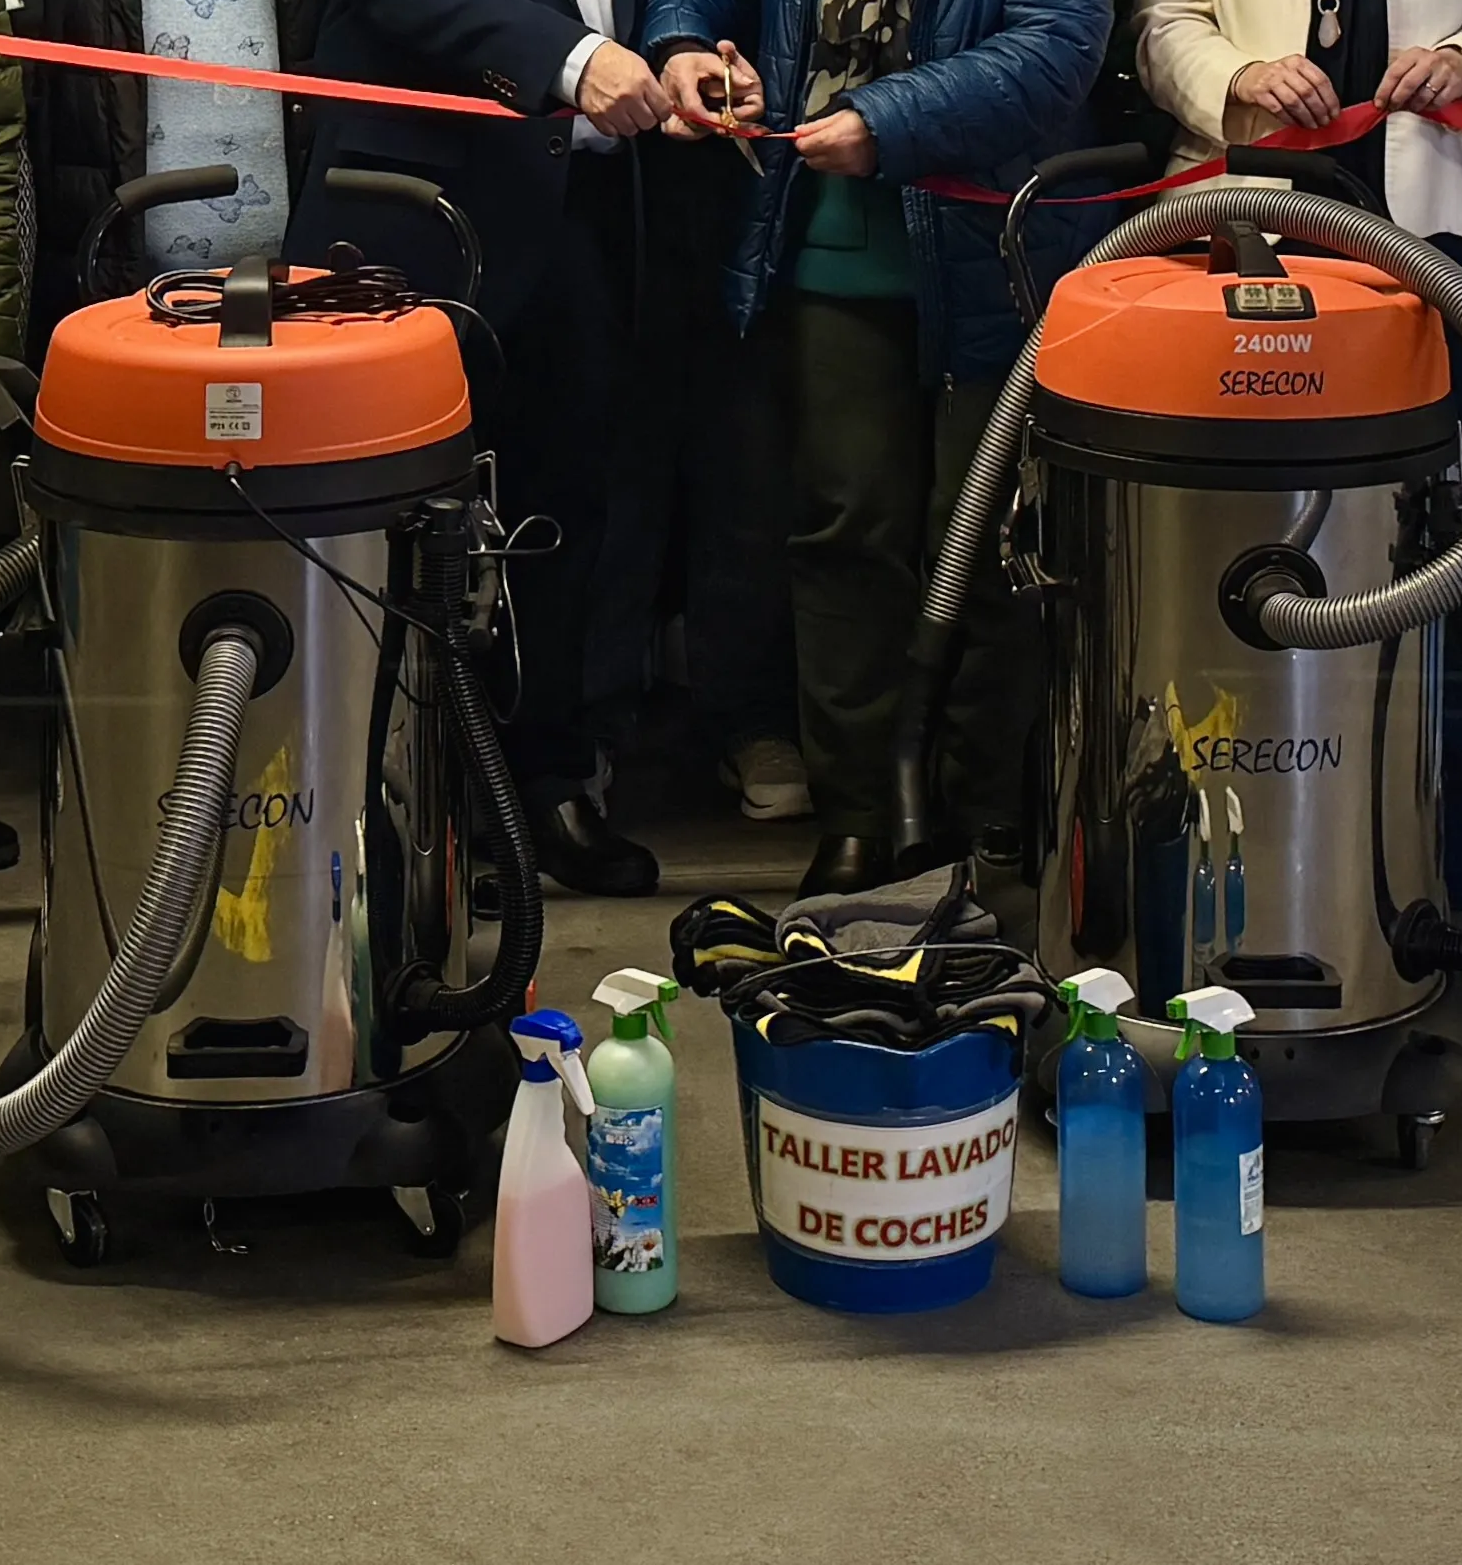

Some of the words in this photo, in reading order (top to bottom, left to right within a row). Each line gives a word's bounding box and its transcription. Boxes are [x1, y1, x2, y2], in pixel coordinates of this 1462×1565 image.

[1233, 333, 1313, 355] 2400W
[1218, 370, 1325, 397] SERECON
[1191, 734, 1343, 776] SERECON
[762, 1119, 887, 1182] TALLER
[896, 1116, 1015, 1182] LAVADO
[798, 1205, 844, 1244] DE
[853, 1198, 989, 1250] COCHES
